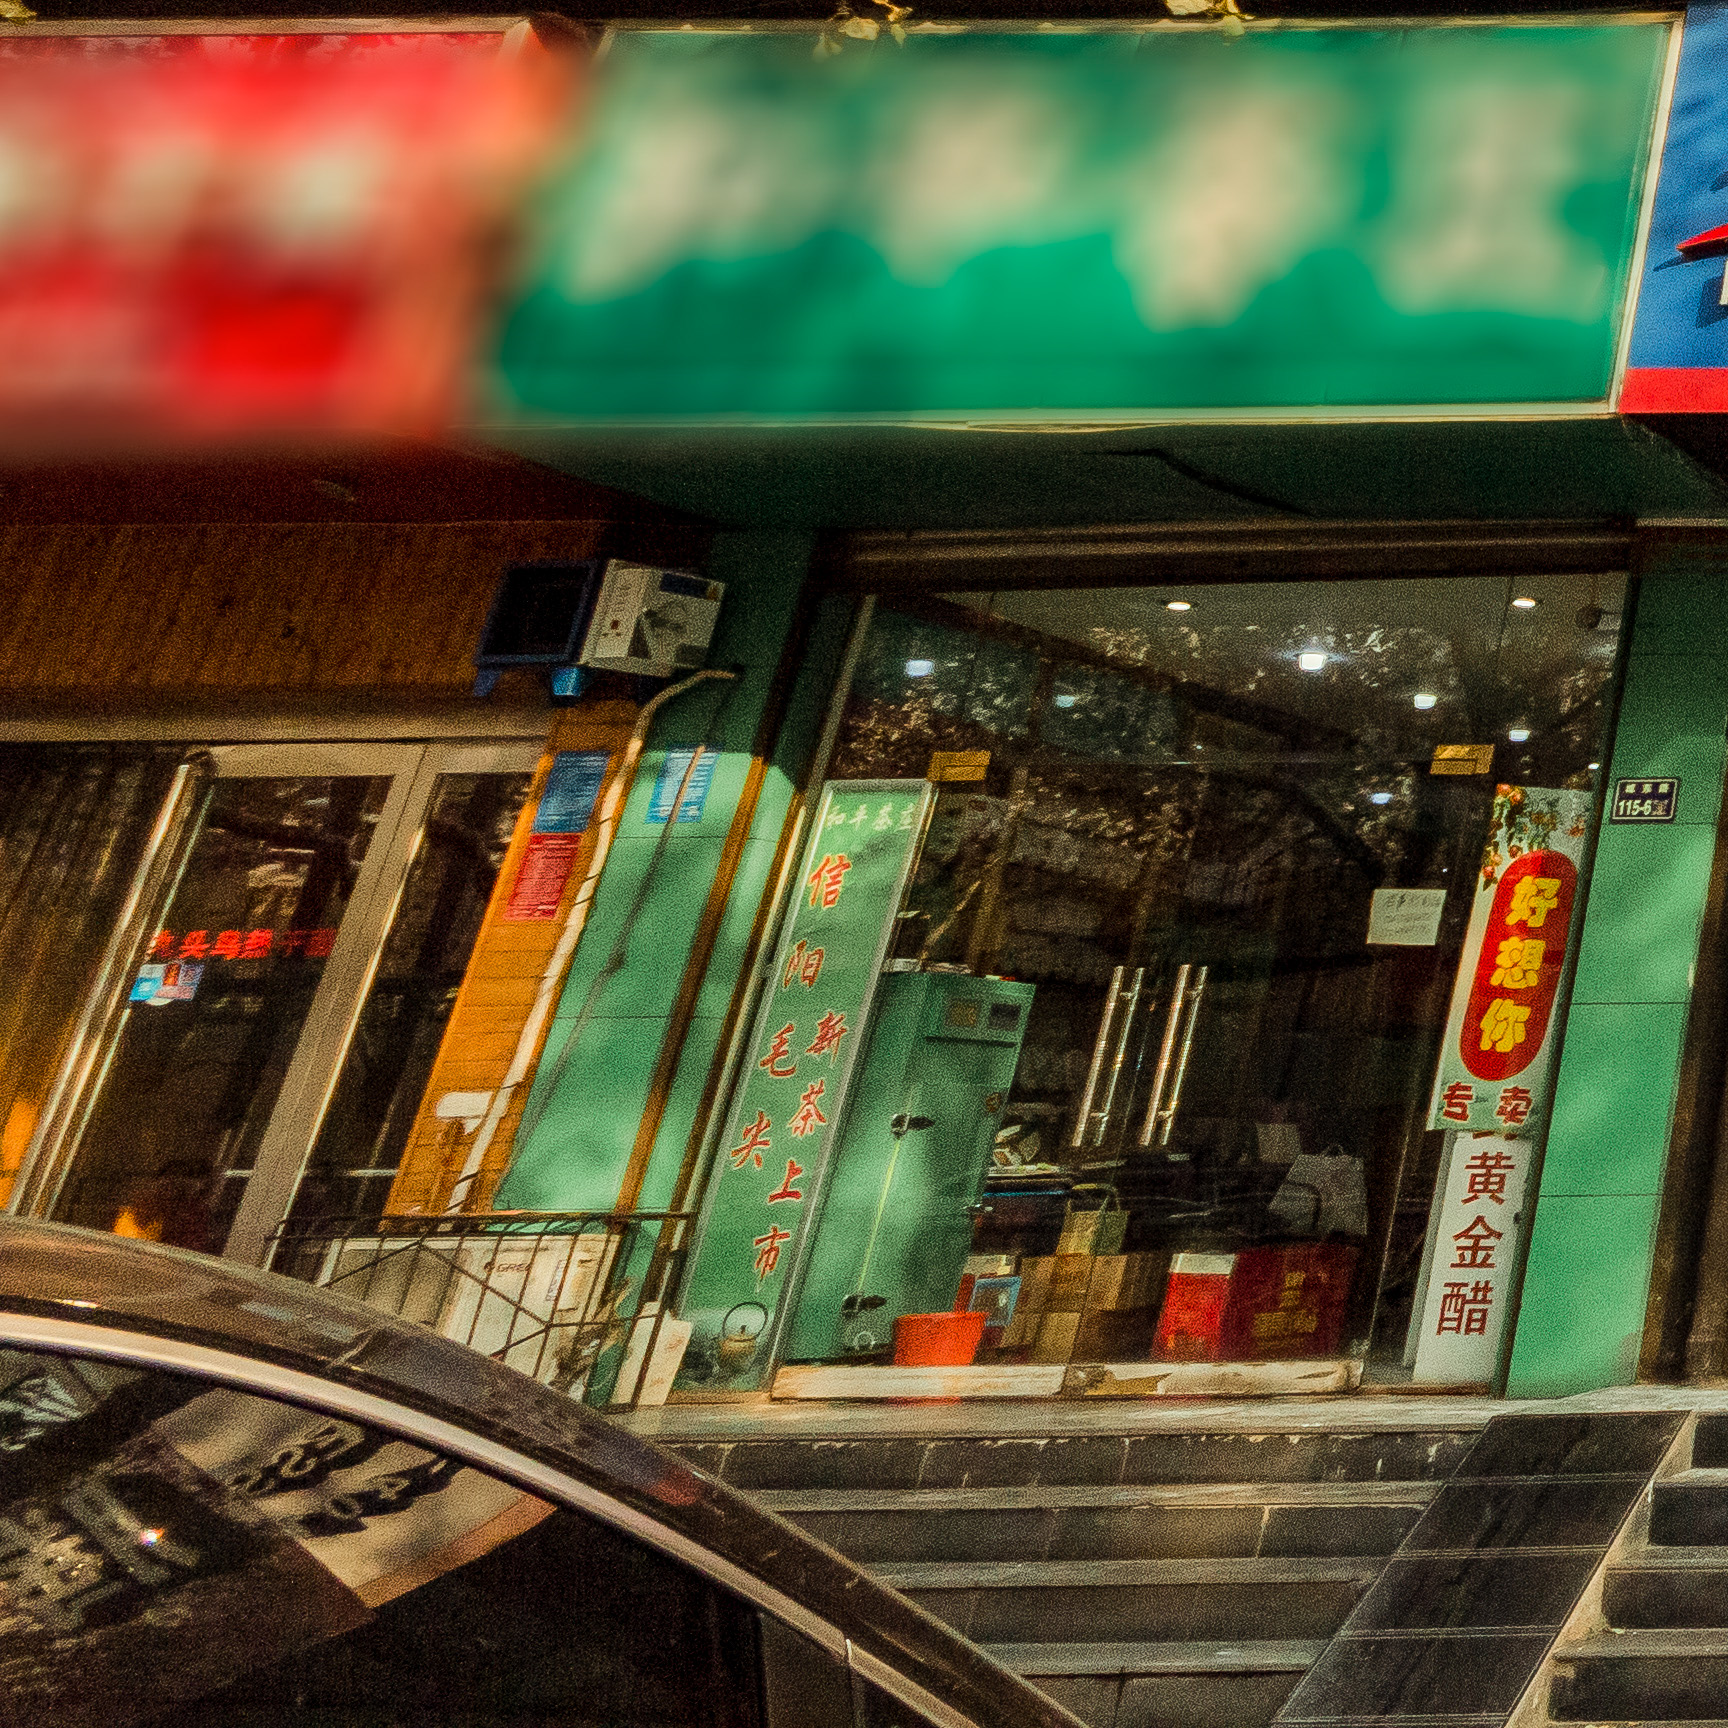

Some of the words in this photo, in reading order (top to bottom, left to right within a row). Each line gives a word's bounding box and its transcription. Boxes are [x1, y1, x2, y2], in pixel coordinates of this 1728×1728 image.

[731, 854, 851, 1171] 信阳毛尖
[1479, 874, 1560, 1053] 好想你
[752, 1011, 850, 1276] 新茶上市
[1441, 1082, 1534, 1125] 专卖
[1436, 1130, 1517, 1337] 黄金醋
